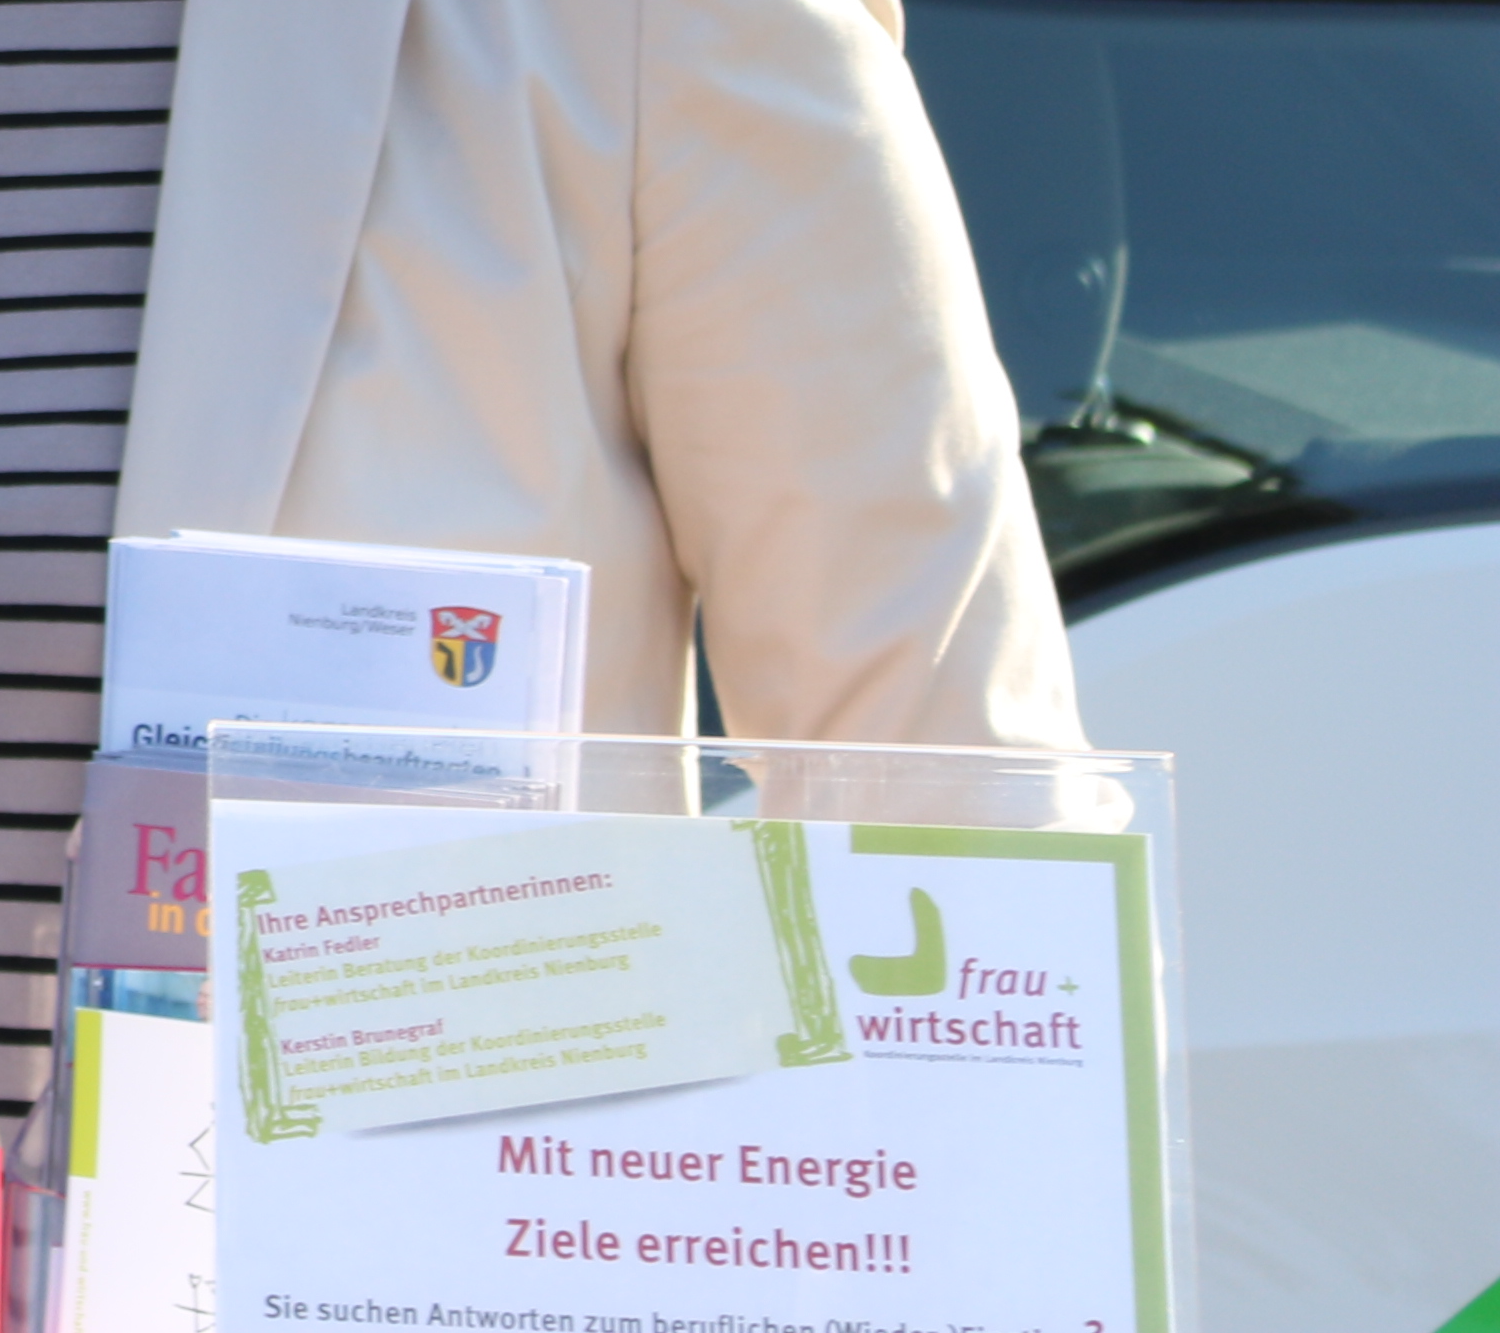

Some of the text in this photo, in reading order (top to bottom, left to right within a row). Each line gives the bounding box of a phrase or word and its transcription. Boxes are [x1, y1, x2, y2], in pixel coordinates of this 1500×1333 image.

[340, 603, 417, 622] Landkreis
[126, 823, 208, 903] Fa
[148, 891, 185, 932] in
[257, 911, 308, 934] Ihre
[316, 871, 613, 926] Ansprechpartnerinnen:
[263, 935, 380, 963] Katrin Fedler
[268, 921, 661, 989] Leiterin Beratung der Koordinierungsstelle
[421, 976, 445, 994] im
[449, 964, 539, 990] Landkreis
[544, 951, 631, 977] Nienburg
[957, 957, 1048, 1000] frau
[281, 1019, 445, 1055] Kerstin Brunegraf
[283, 1011, 666, 1077] Leiterin Bildung der Koordinierungsstelle
[856, 1006, 1083, 1049] wirtschaft
[437, 1064, 461, 1083] im
[465, 1053, 556, 1080] Landkreis
[561, 1040, 648, 1067] Nienburg
[498, 1134, 917, 1198] Mit neuer Energie
[505, 1218, 912, 1274] Ziele erreichen!!!
[264, 1294, 308, 1320] Sie
[316, 1299, 418, 1326] suchen
[426, 1303, 575, 1333] Antworten
[584, 1315, 642, 1333] zum
